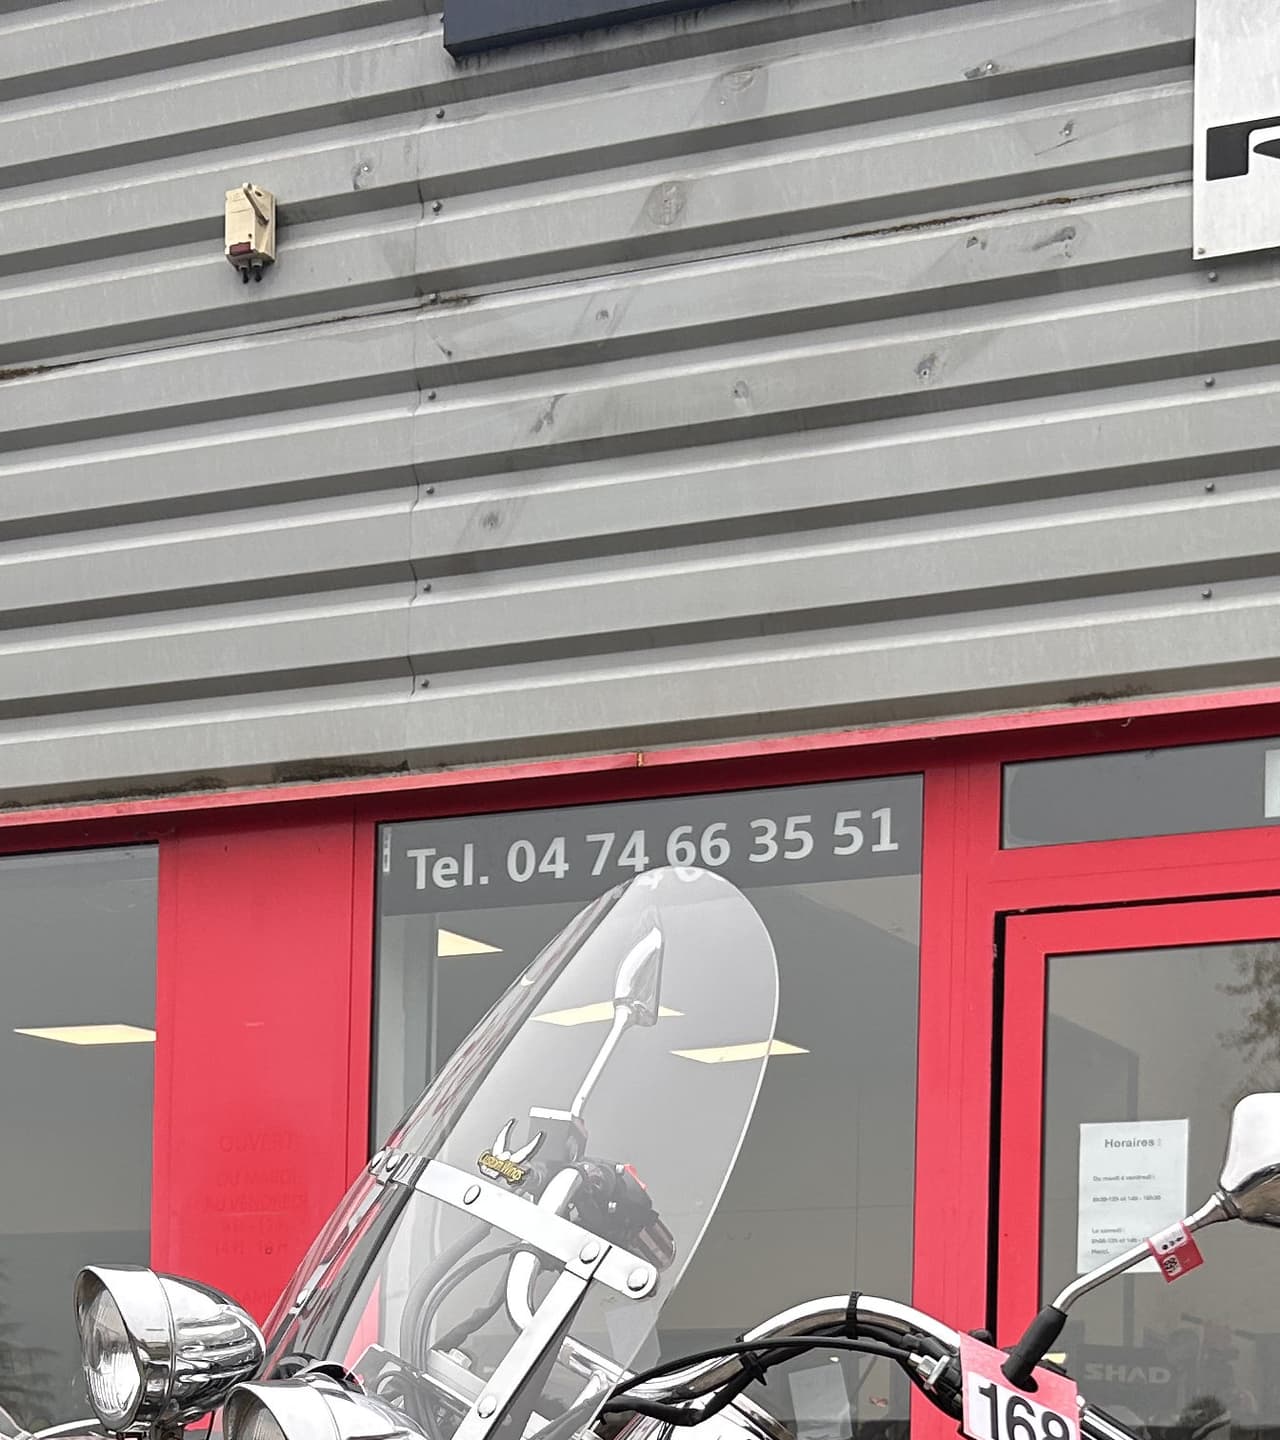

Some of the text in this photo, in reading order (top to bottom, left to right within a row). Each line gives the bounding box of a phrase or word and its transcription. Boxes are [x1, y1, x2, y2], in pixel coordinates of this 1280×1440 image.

[407, 806, 899, 890] Tel. 04 74 66 35 51
[1104, 1138, 1155, 1149] Horaires
[1083, 1362, 1171, 1384] SHAD
